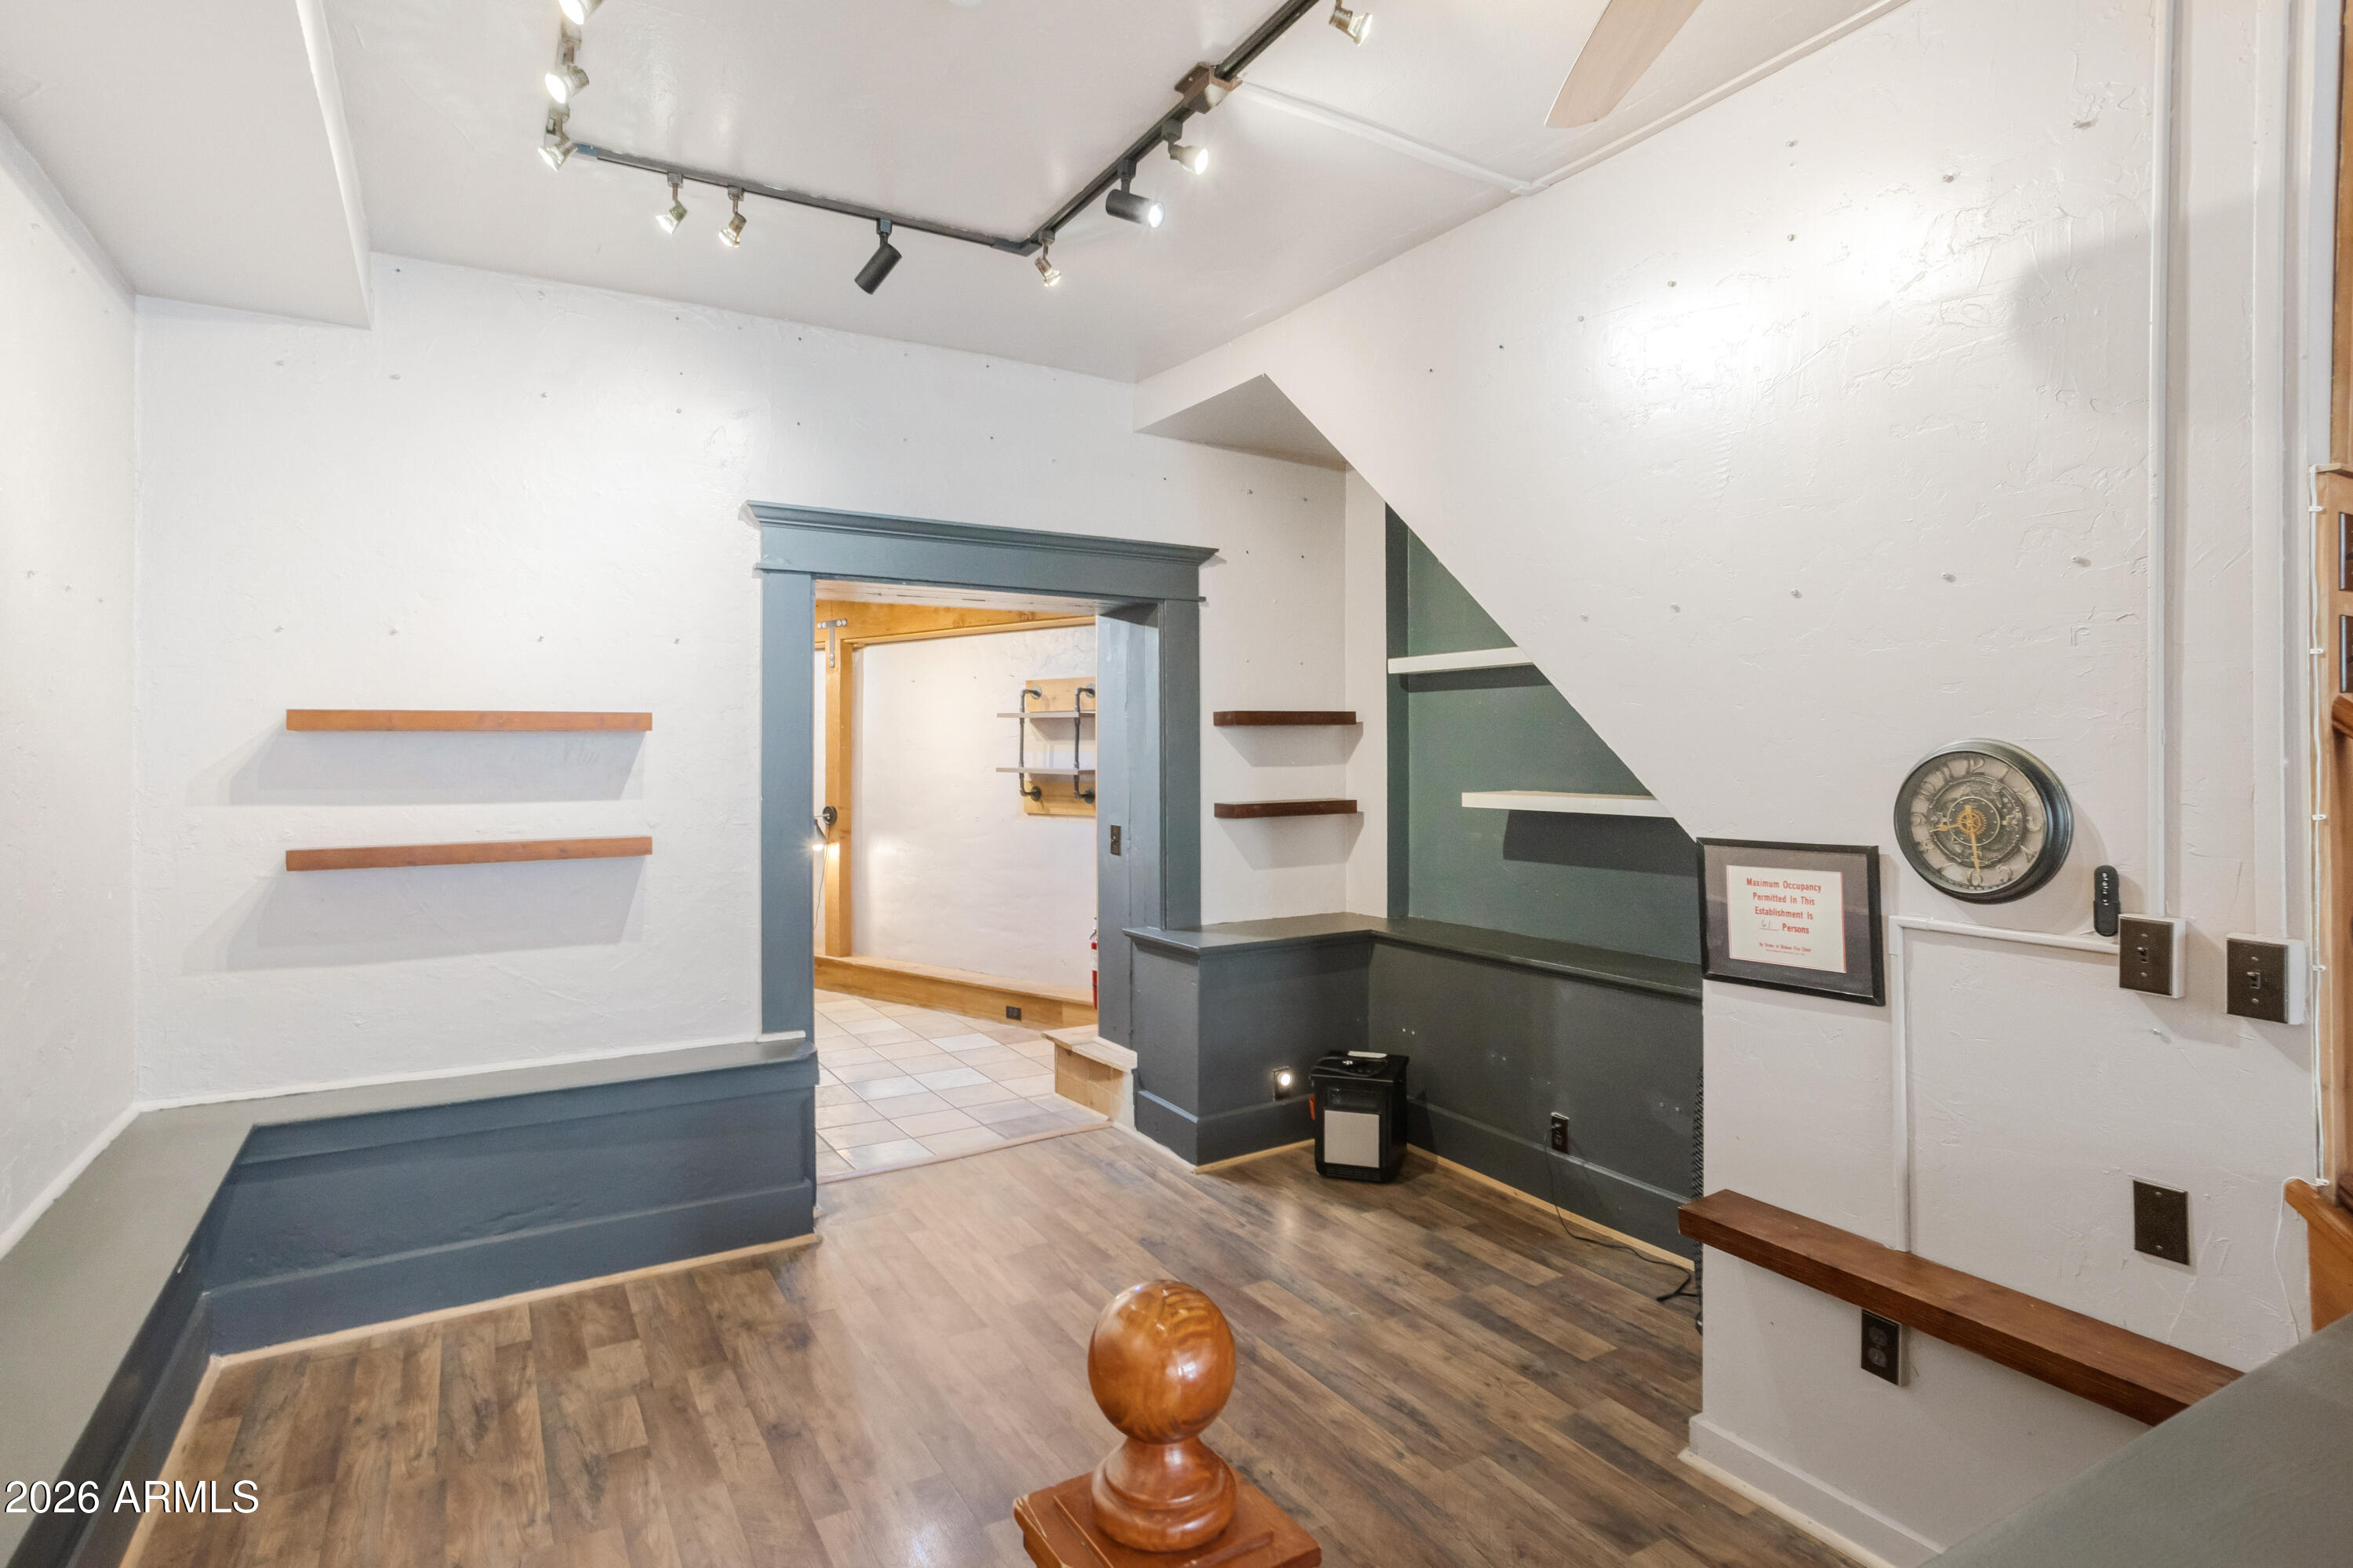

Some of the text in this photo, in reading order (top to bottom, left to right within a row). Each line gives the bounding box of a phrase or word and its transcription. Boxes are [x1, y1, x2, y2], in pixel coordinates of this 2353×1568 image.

[1964, 757, 1985, 775] 12
[1747, 878, 1821, 893] Maximum Occupancy
[1752, 892, 1815, 906] Permitted In This
[1755, 906, 1813, 920] Establishment Is
[1782, 922, 1809, 934] Persons
